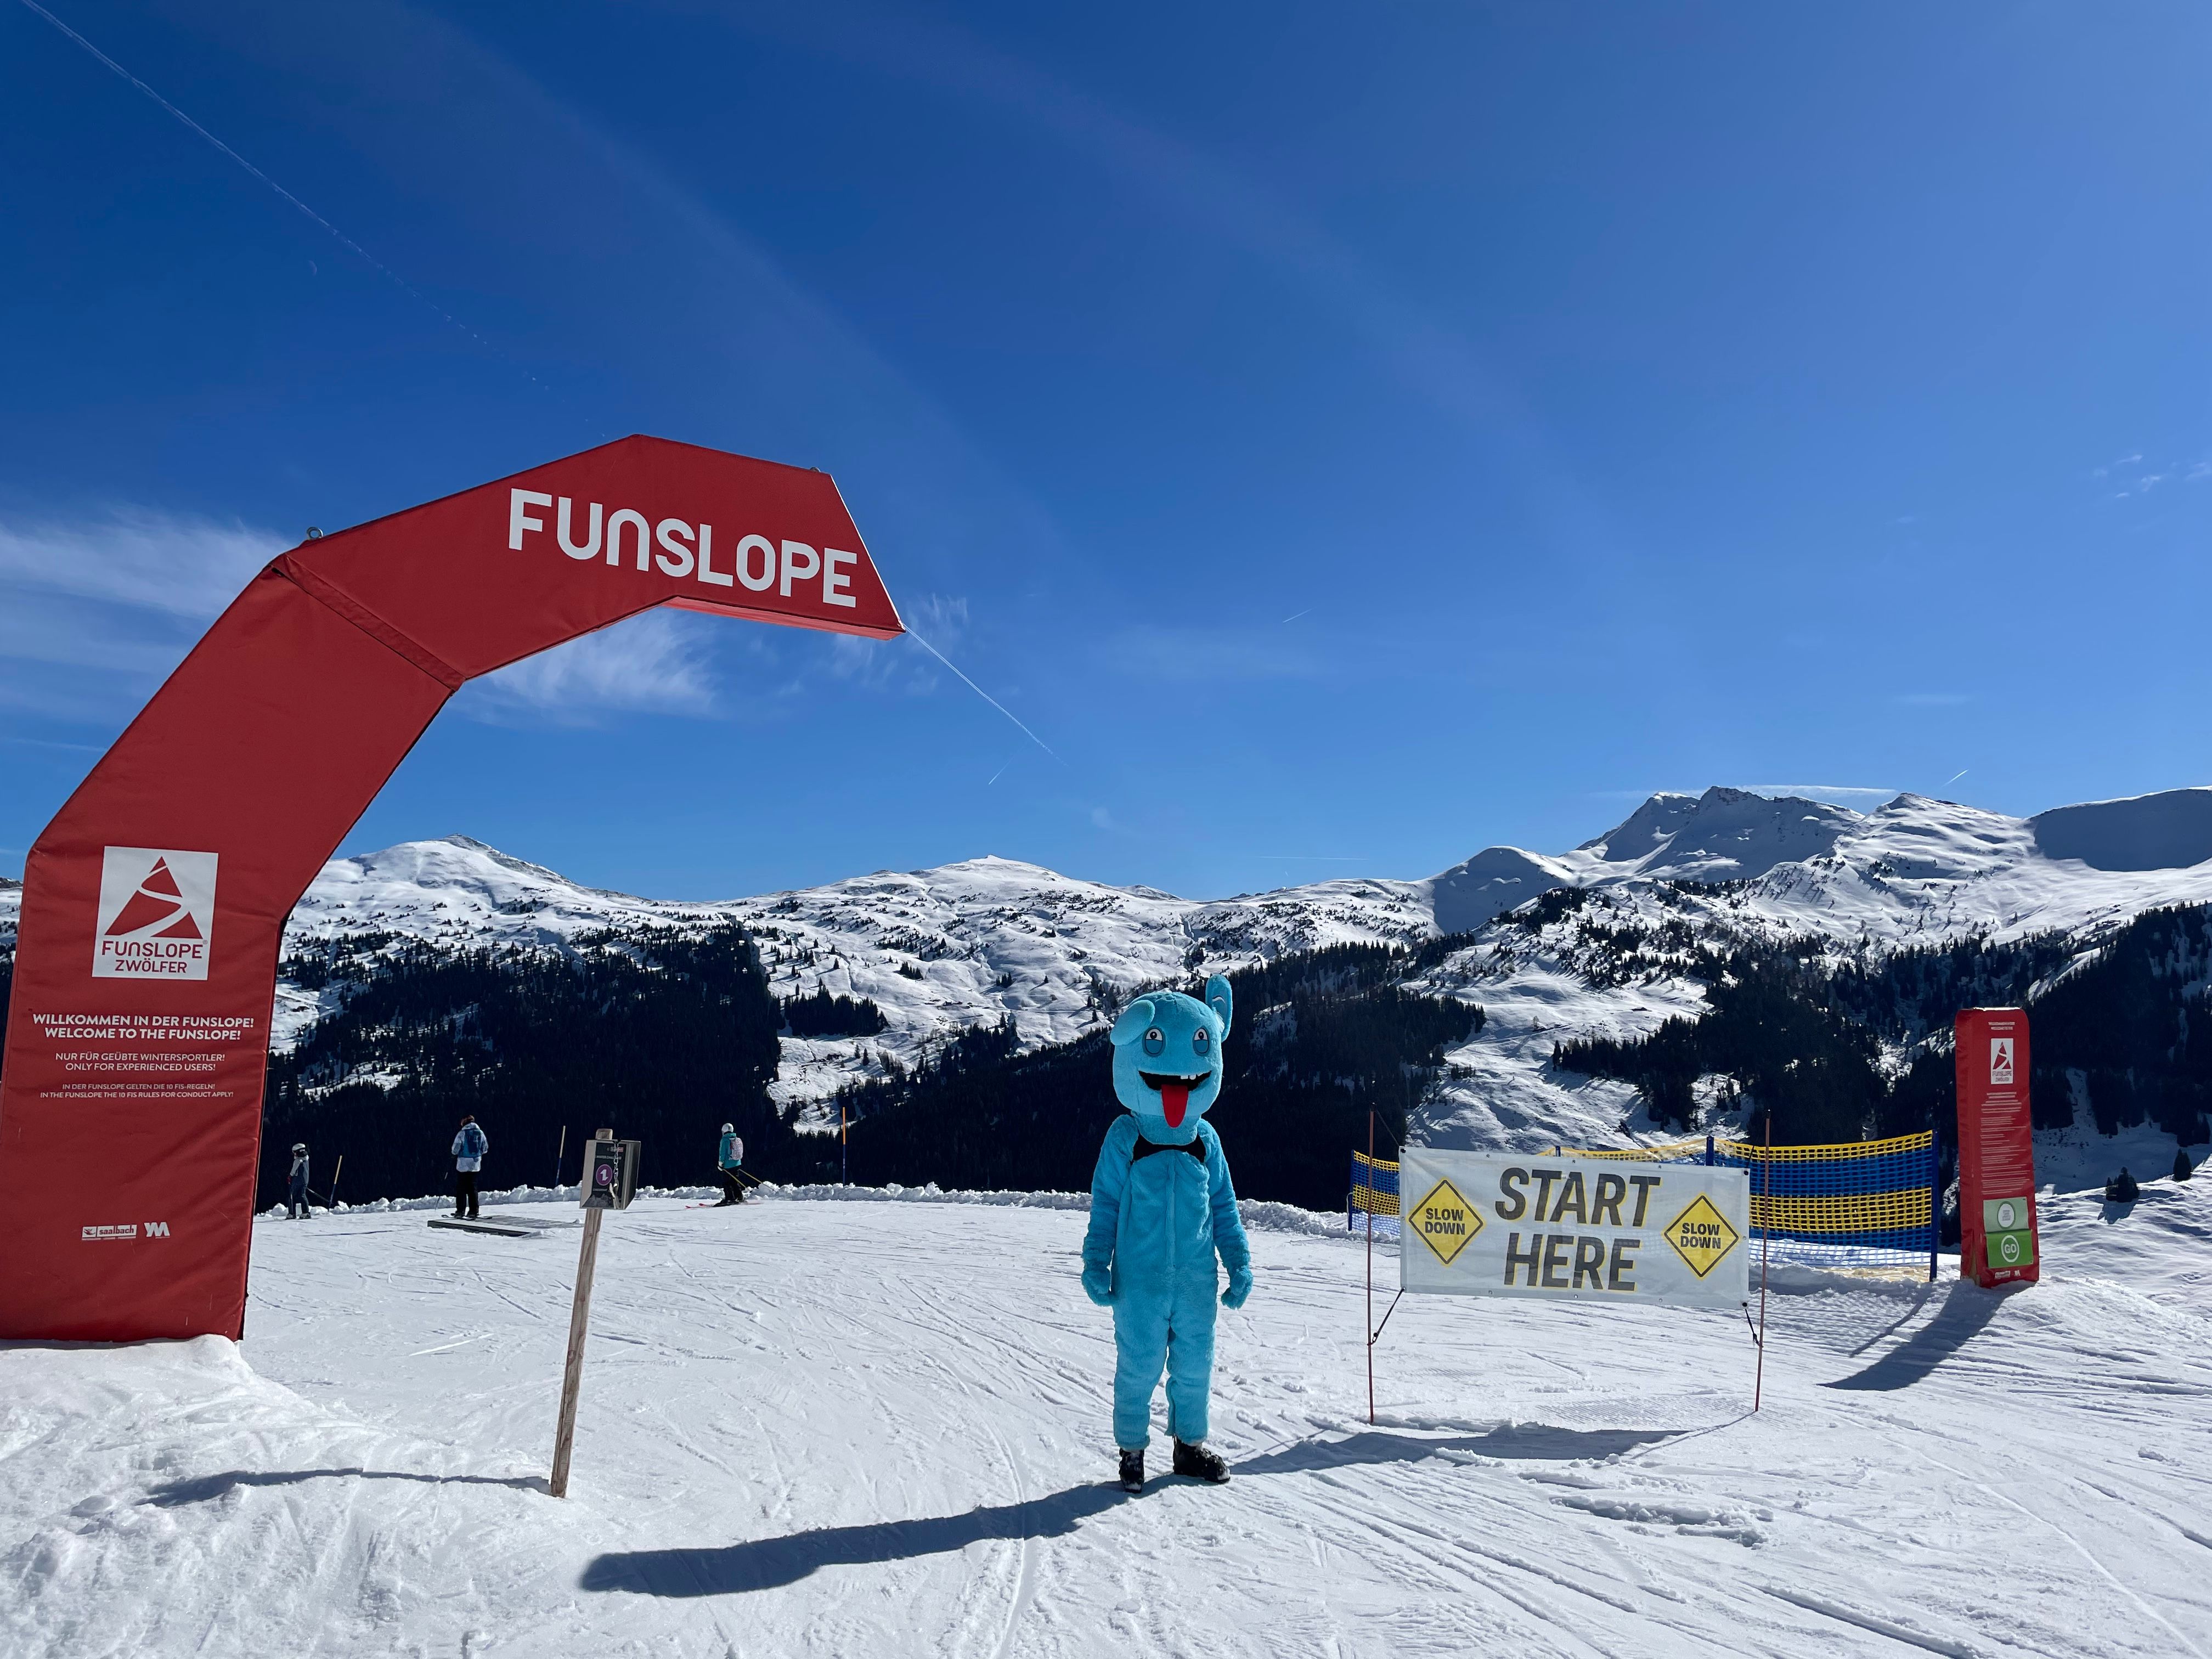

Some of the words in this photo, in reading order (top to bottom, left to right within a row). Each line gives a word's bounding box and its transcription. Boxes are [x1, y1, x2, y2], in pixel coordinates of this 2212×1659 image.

[509, 488, 857, 608] FUNSLOPE
[101, 940, 203, 958] FUNSLOPE
[115, 958, 187, 973] ZWÖLFER
[33, 1014, 130, 1025] WILLKOMMEN
[134, 1015, 149, 1025] IN
[152, 1016, 179, 1026] DER
[183, 1017, 254, 1028] FUNSLOPE!
[45, 1027, 116, 1039] WELCOME
[119, 1028, 137, 1039] TO
[139, 1029, 166, 1039] THE
[168, 1029, 241, 1040] FUNSLOPE!
[80, 1051, 99, 1060] FÜR
[101, 1051, 138, 1061] GEÜBTE
[140, 1053, 225, 1062] WINTERSPORTLER!
[116, 1063, 182, 1071] EXPERIENCED
[1495, 1167, 1662, 1227] START
[1426, 1207, 1464, 1221] SLOW
[99, 1225, 134, 1234] saalbach
[1425, 1221, 1465, 1235] DOWN
[1682, 1222, 1720, 1235] SLOW
[1680, 1235, 1721, 1249] DOWN
[2004, 1244, 2017, 1254] GO
[1504, 1232, 1640, 1291] HERE
